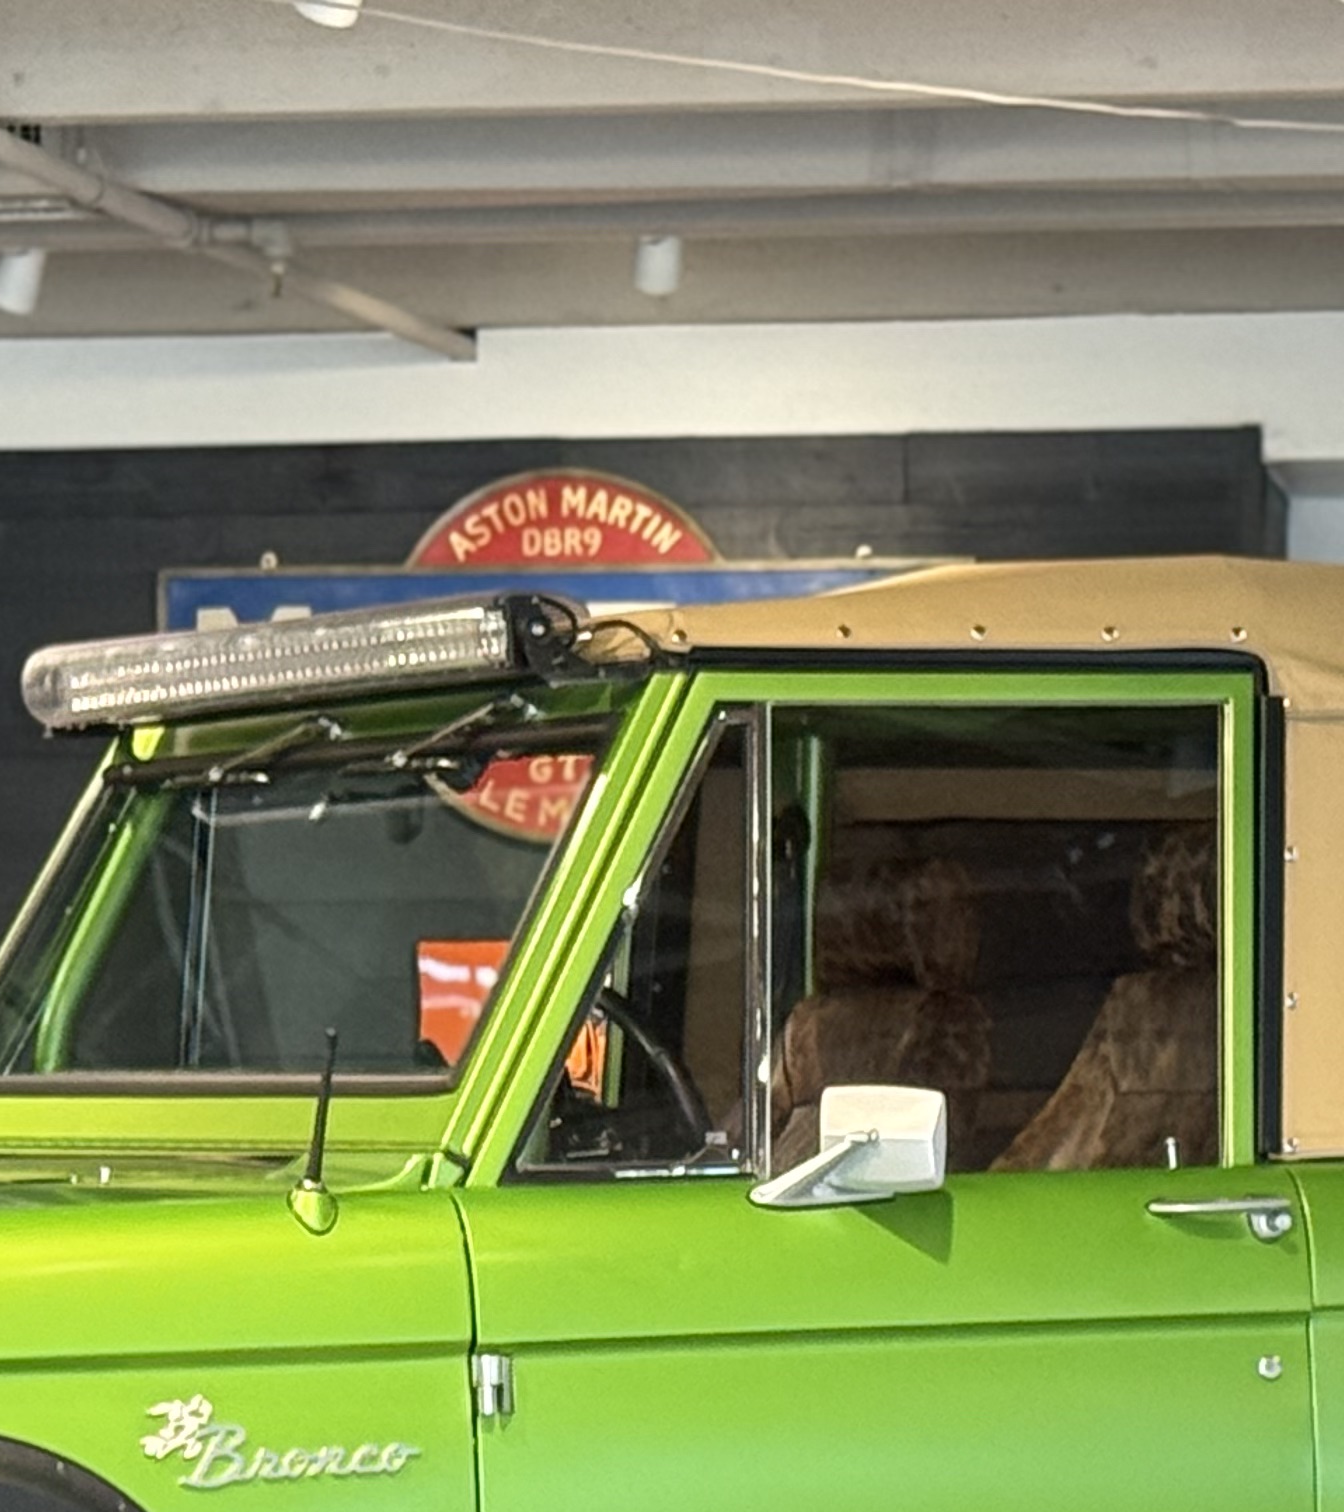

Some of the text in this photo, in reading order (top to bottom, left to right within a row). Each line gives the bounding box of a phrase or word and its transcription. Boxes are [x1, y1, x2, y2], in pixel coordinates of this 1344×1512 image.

[449, 485, 682, 562] ASTON MARTIN
[522, 527, 602, 556] DBR9
[479, 779, 531, 823] LE
[177, 1423, 422, 1488] Bronco
